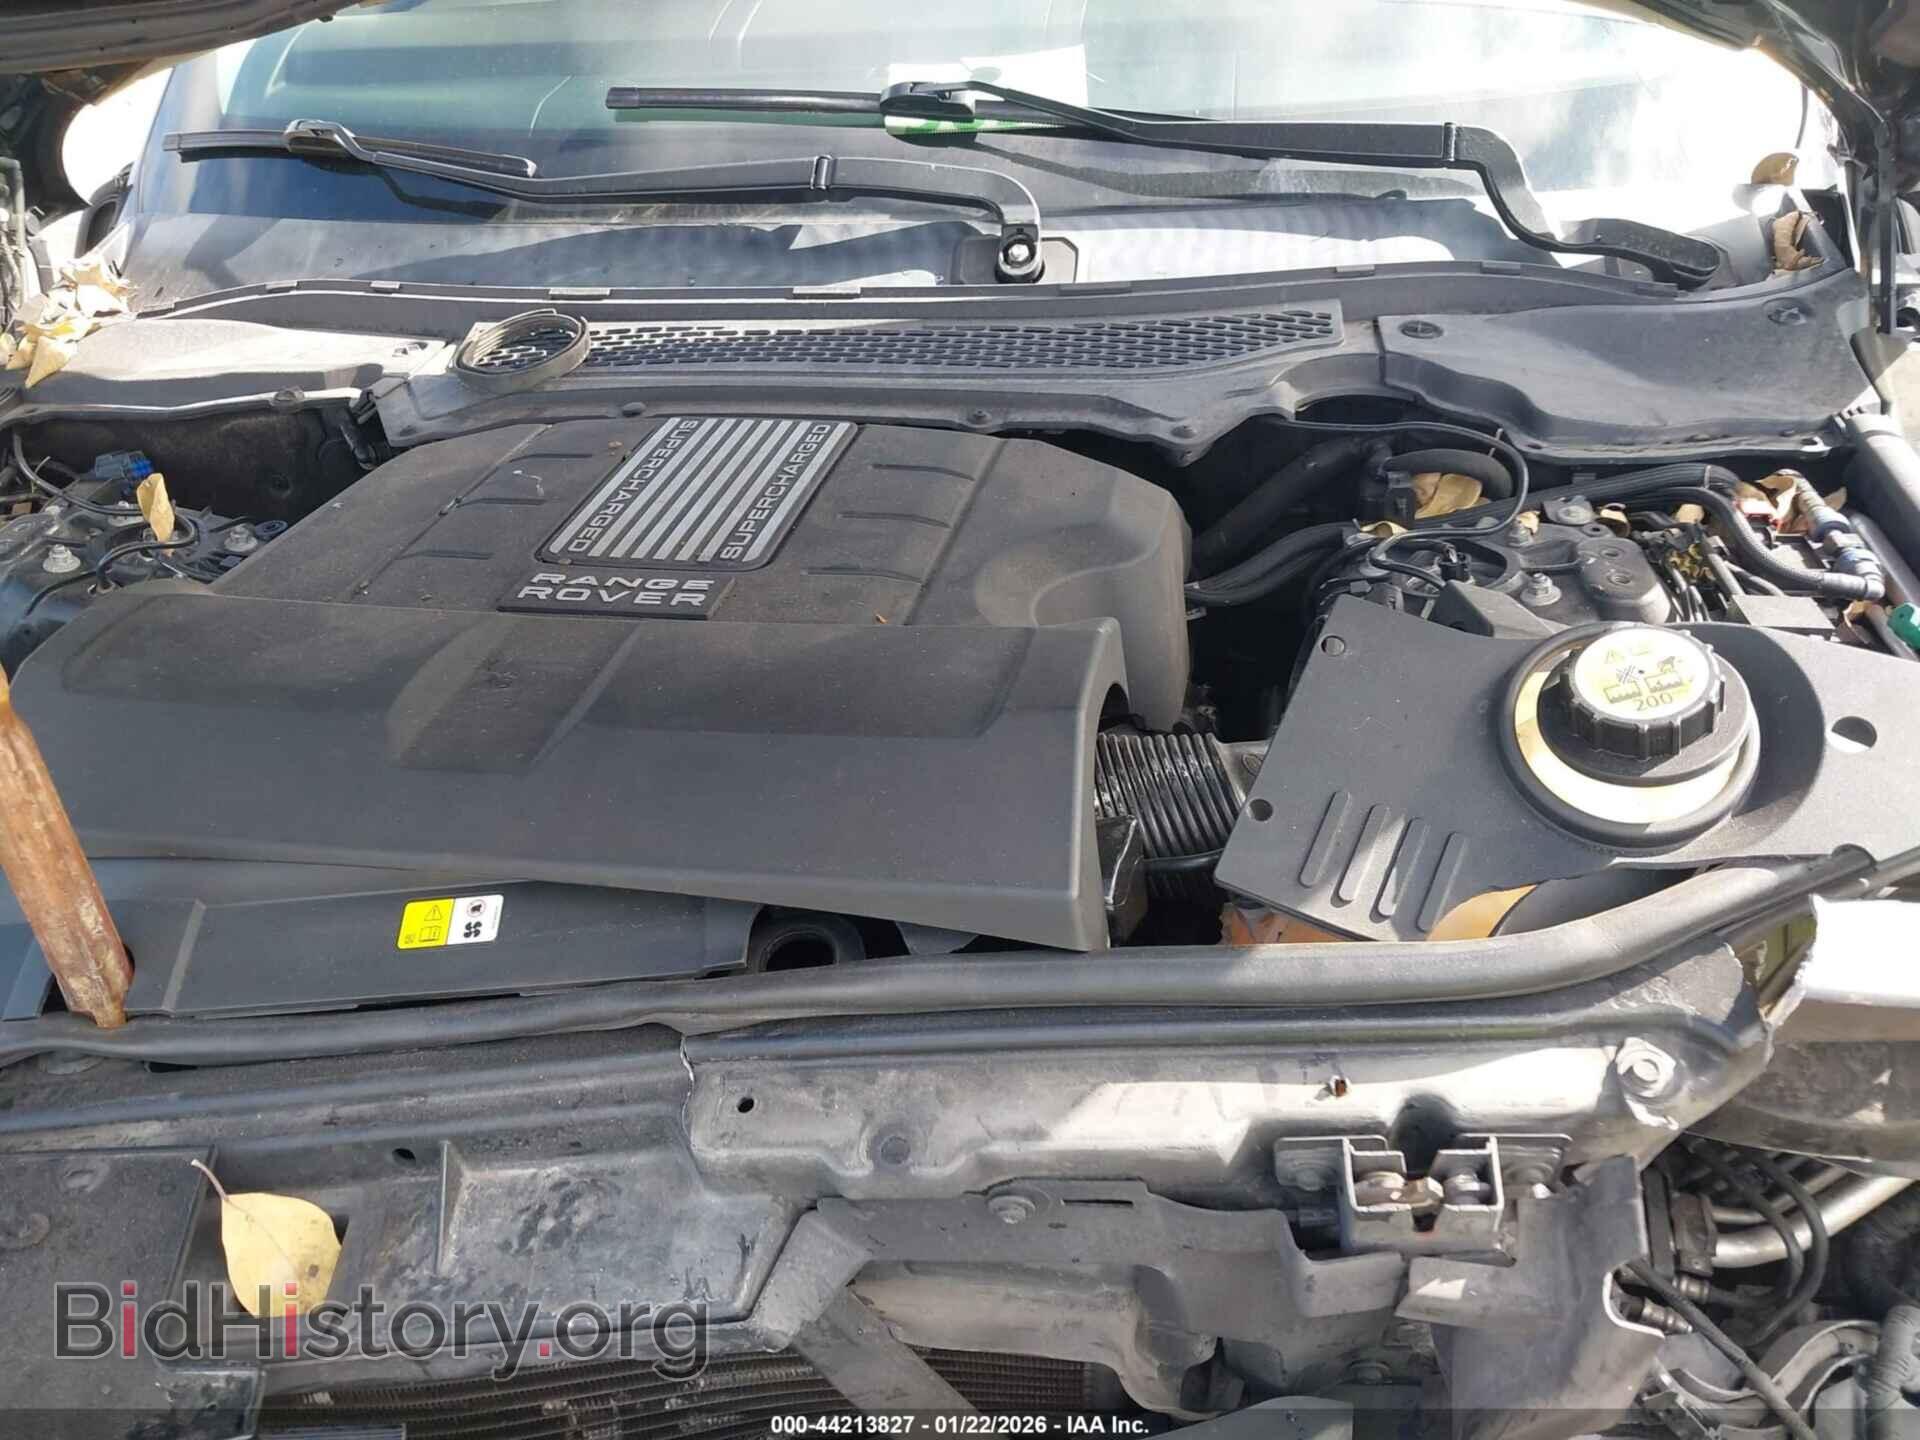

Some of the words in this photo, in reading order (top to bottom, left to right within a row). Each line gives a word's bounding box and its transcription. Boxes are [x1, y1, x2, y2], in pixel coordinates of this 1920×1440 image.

[569, 420, 698, 553] SUPERCHARGED
[720, 423, 831, 560] SUPERCHARGED
[530, 572, 716, 591] RANGE
[517, 585, 708, 607] ROVER
[1632, 691, 1674, 712] 200
